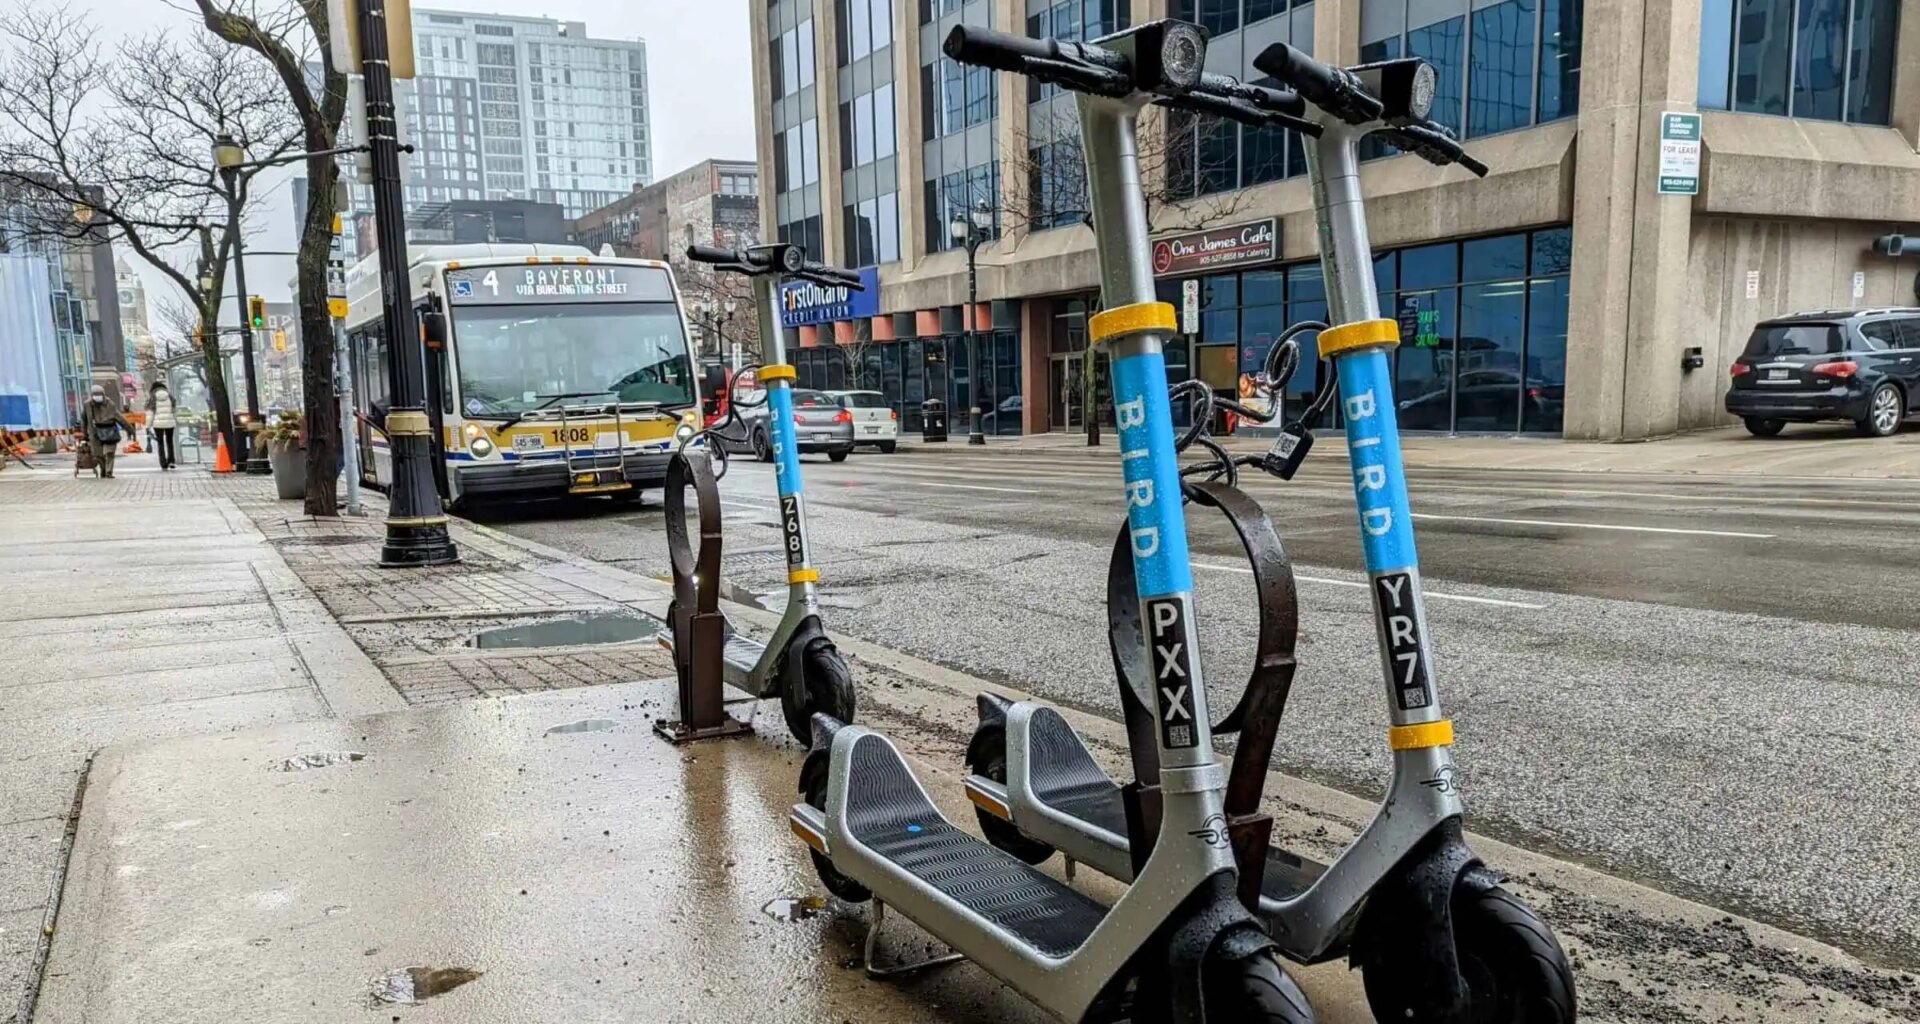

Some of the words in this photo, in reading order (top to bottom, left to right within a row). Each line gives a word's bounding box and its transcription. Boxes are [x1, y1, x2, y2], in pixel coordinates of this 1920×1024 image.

[1171, 240, 1196, 256] One
[1200, 235, 1237, 252] James
[1241, 225, 1273, 245] Cafe
[482, 270, 499, 296] 4
[525, 269, 616, 285] BAYFRONT
[516, 285, 535, 296] VIA
[536, 284, 594, 296] BURLINGTON
[596, 283, 628, 295] STREET
[783, 309, 814, 325] CREDIT
[820, 305, 849, 320] UNION
[552, 428, 589, 443] 1808
[1116, 395, 1160, 558] BIRD
[1345, 388, 1393, 537] BIRD
[784, 498, 801, 552] Z68
[1381, 576, 1418, 684] YR7
[1153, 603, 1191, 721] PXX
